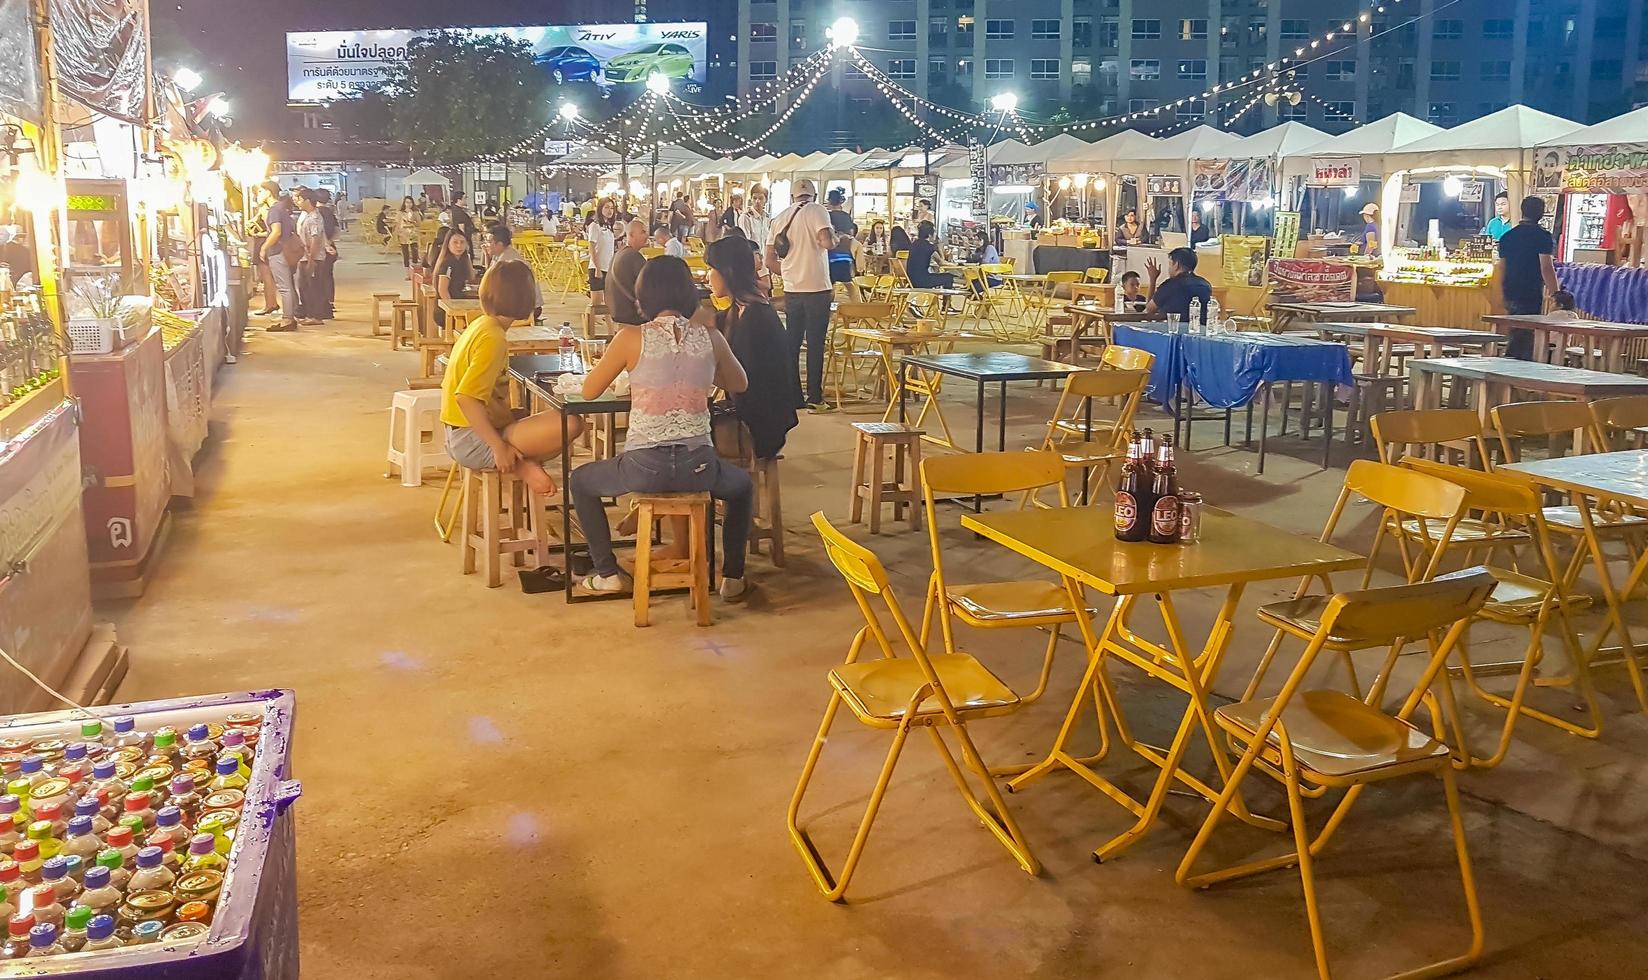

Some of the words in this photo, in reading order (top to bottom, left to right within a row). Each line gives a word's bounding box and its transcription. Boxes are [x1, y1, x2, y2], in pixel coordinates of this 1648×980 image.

[578, 32, 617, 41] ATIV
[660, 30, 701, 40] YARIS
[340, 80, 347, 89] 5
[1115, 504, 1134, 517] LEO
[1156, 510, 1178, 521] LEO
